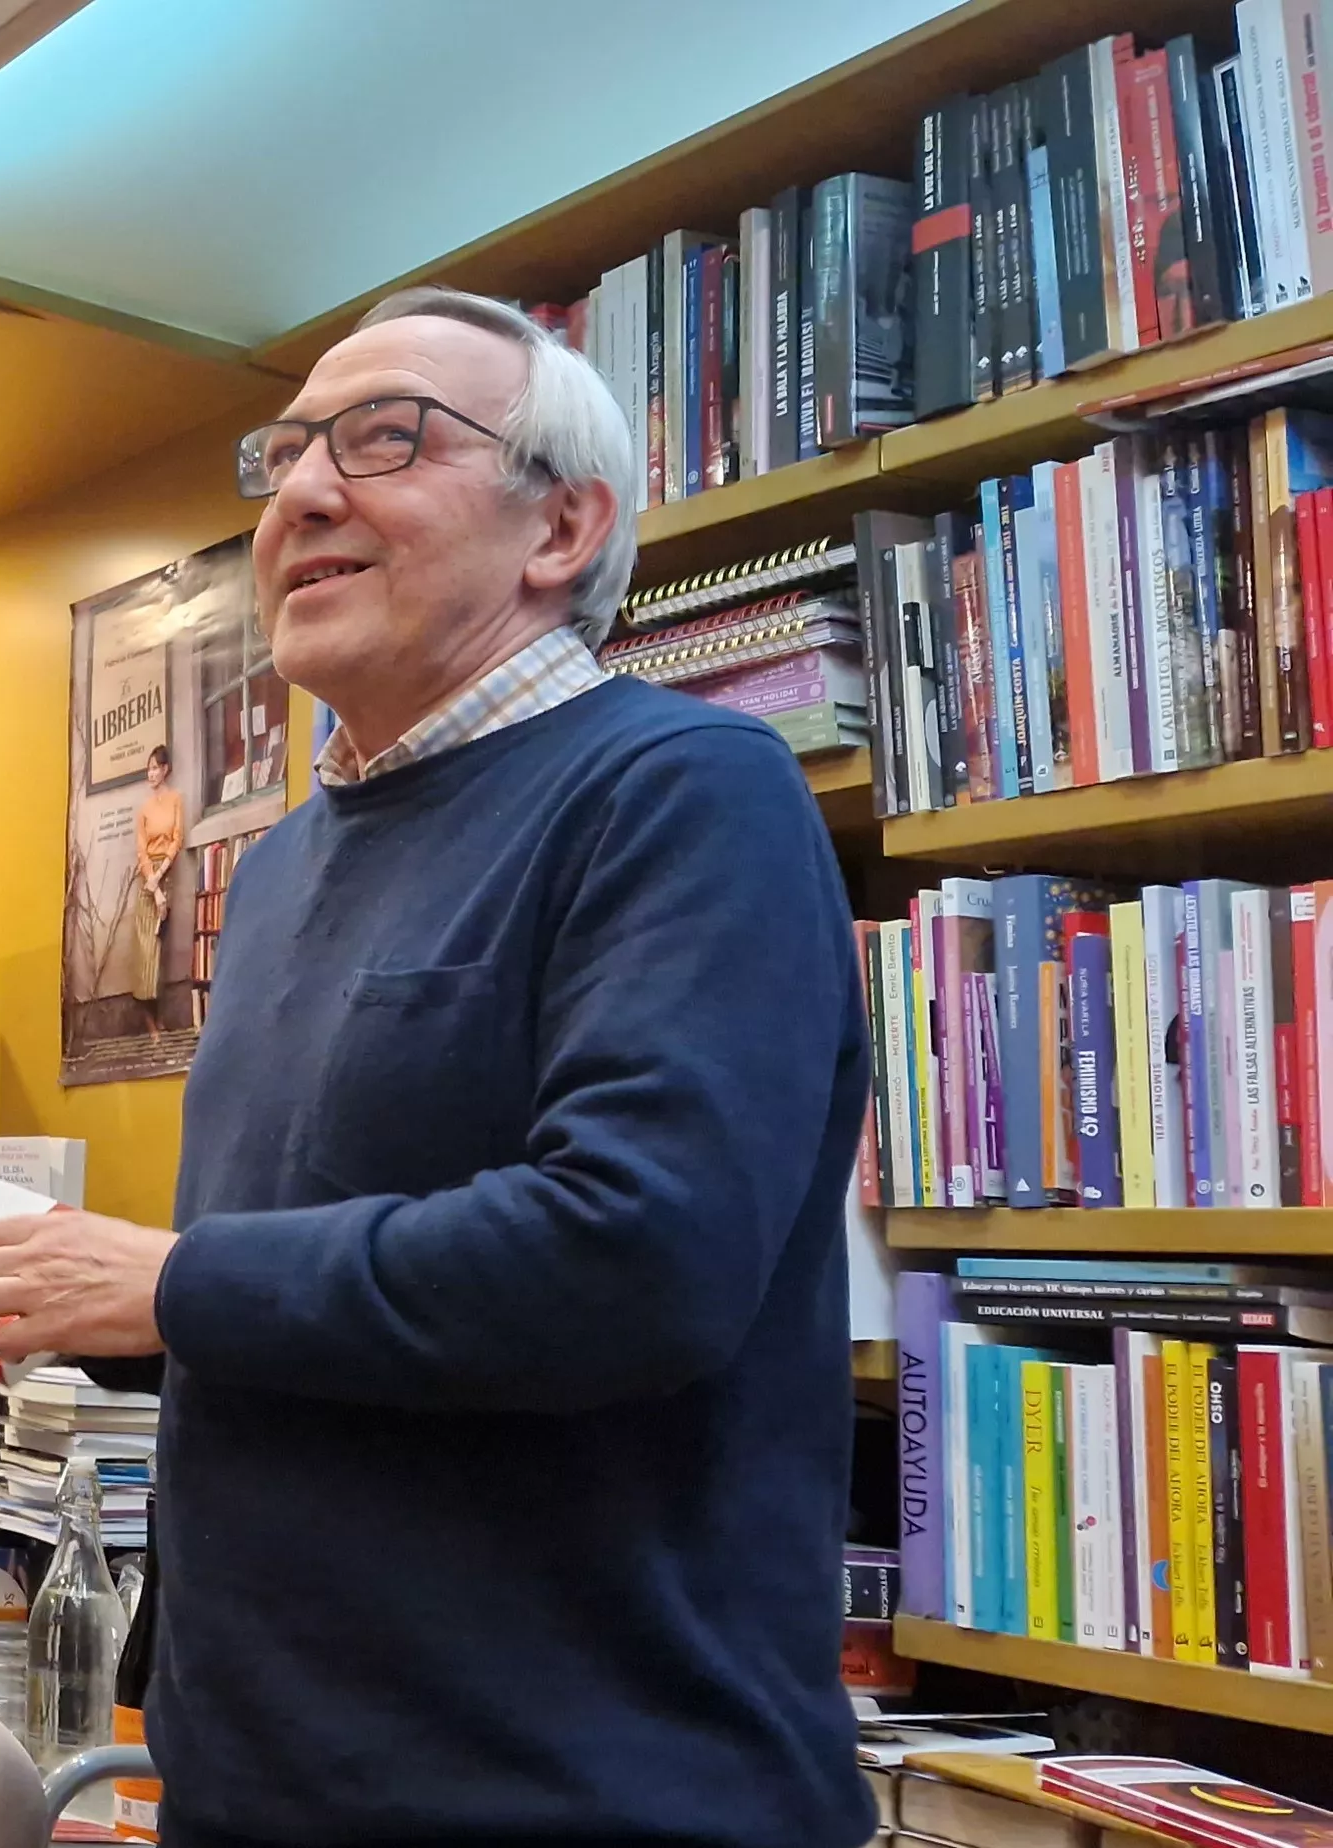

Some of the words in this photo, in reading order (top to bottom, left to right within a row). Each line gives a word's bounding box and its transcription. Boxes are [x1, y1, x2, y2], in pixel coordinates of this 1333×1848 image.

[923, 195, 934, 211] LA
[648, 331, 662, 376] Aragón
[776, 341, 789, 359] LA
[648, 379, 660, 395] de
[776, 399, 789, 417] LA
[1151, 548, 1169, 633] MONTESCOS
[1110, 612, 1123, 678] ALMANAQUE
[1156, 639, 1169, 650] Y
[1011, 657, 1025, 694] COSTA
[93, 680, 163, 749] LIBRERÍA
[1157, 655, 1175, 741] CAPULETOS
[1013, 696, 1029, 747] JOAQUÍN
[1184, 894, 1199, 950] ¿EXISTIERON
[886, 933, 898, 970] Benito
[1188, 950, 1200, 967] LAS
[886, 972, 898, 1000] Enric
[1079, 968, 1089, 998] NURIA
[1148, 992, 1161, 1007] LA
[1189, 967, 1202, 1016] ROMANAS?
[889, 1014, 900, 1056] MUERTE
[1080, 999, 1090, 1037] VARELA
[1149, 1008, 1162, 1055] BELLEZA
[1243, 986, 1258, 1050] ALTERNATIVAS
[1077, 1050, 1098, 1113] FEMINISMO
[1152, 1062, 1164, 1108] SIMONE
[1245, 1052, 1259, 1086] FALSAS
[1246, 1087, 1259, 1105] LAS
[1154, 1113, 1165, 1141] WEIL
[977, 1305, 1040, 1318] EDUCACIÓN
[1041, 1306, 1106, 1320] UNIVERSAL
[1166, 1363, 1180, 1379] EL
[1192, 1364, 1206, 1380] EL
[1024, 1389, 1043, 1455] DYER
[1166, 1384, 1181, 1432] PODER
[1192, 1385, 1207, 1434] PODER
[1210, 1381, 1223, 1424] OSHO
[901, 1351, 928, 1539] AUTOAYUDA
[1168, 1437, 1182, 1463] DEL
[1194, 1439, 1208, 1466] DEL
[1170, 1470, 1184, 1523] AHORA
[1195, 1471, 1210, 1525] AHORA
[843, 1568, 853, 1615] AGENDA
